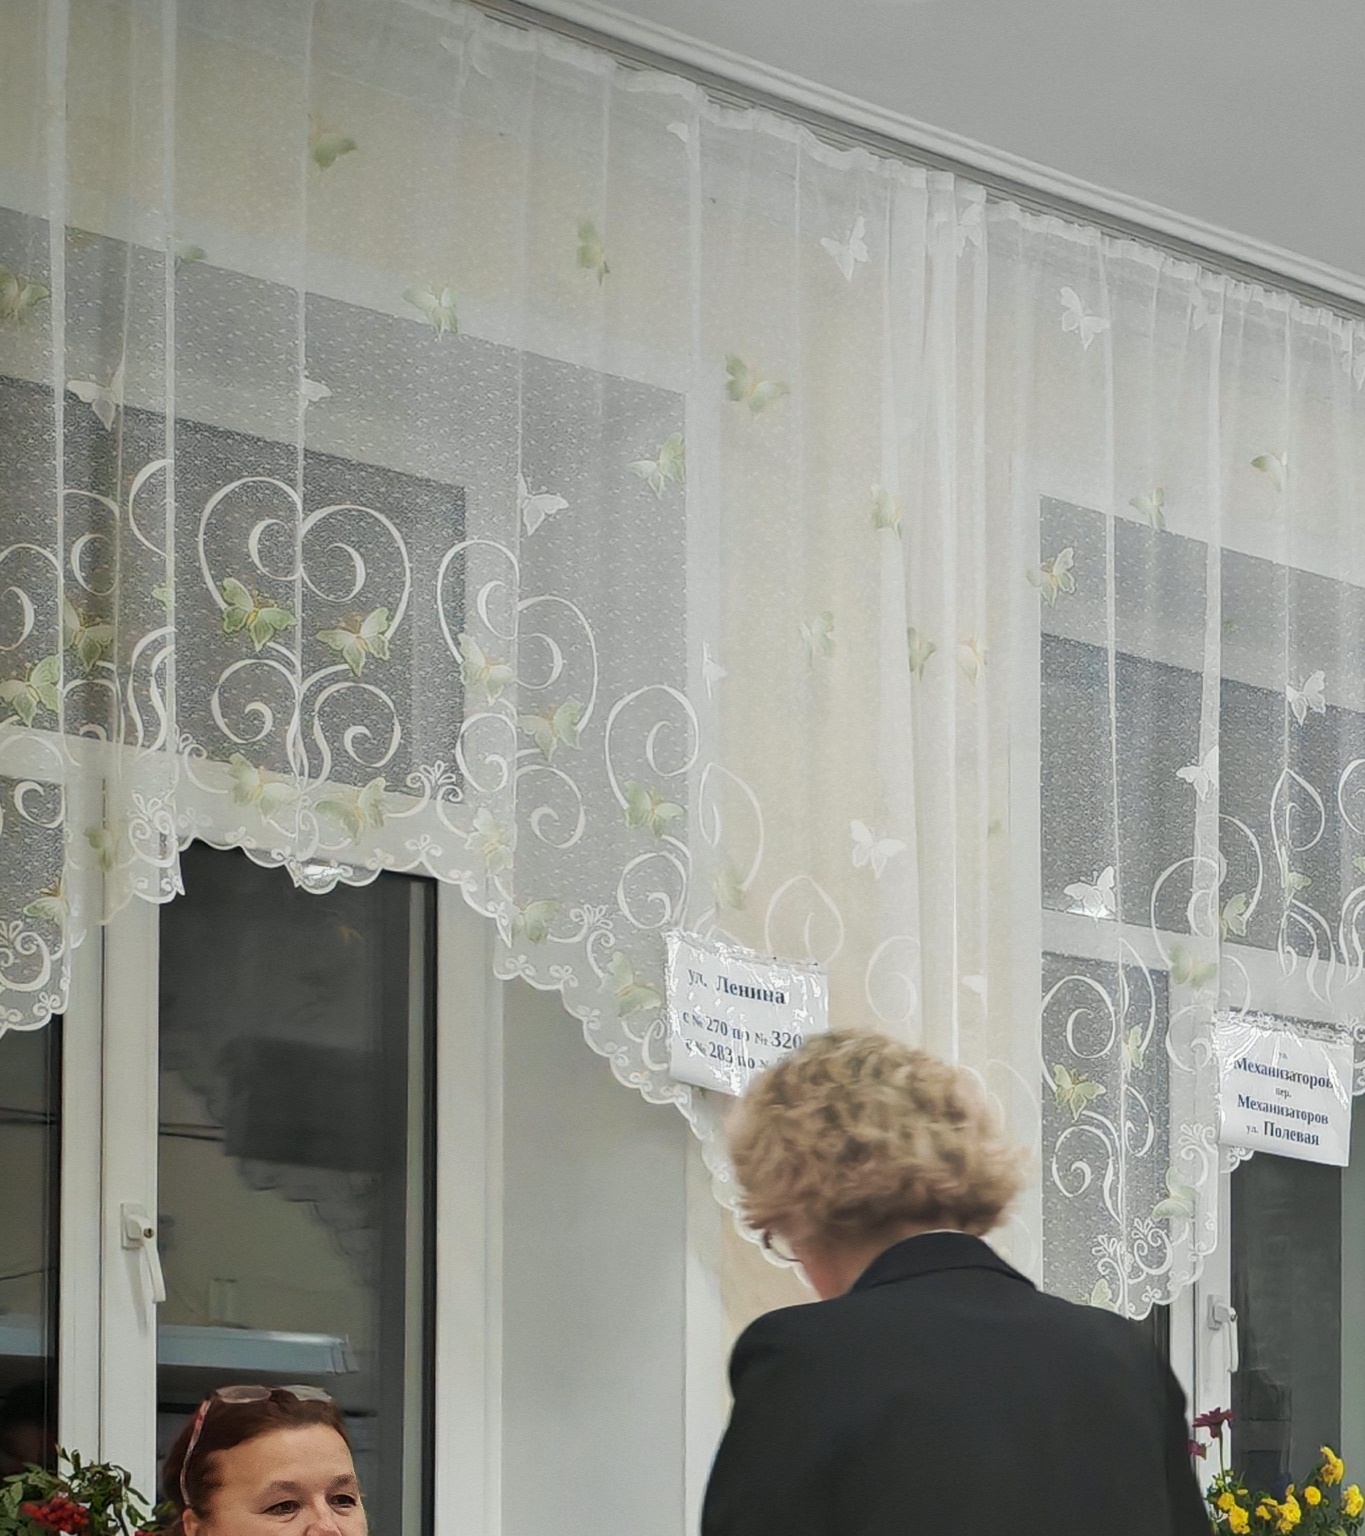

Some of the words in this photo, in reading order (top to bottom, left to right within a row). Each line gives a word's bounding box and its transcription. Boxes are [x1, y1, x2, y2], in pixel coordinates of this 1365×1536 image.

[687, 968, 707, 988] ул.
[716, 975, 786, 1005] Ленина
[706, 1015, 728, 1037] 270
[709, 1041, 734, 1064] 283
[1237, 1093, 1329, 1126] Механизаторов
[1263, 1120, 1320, 1146] Полевая
